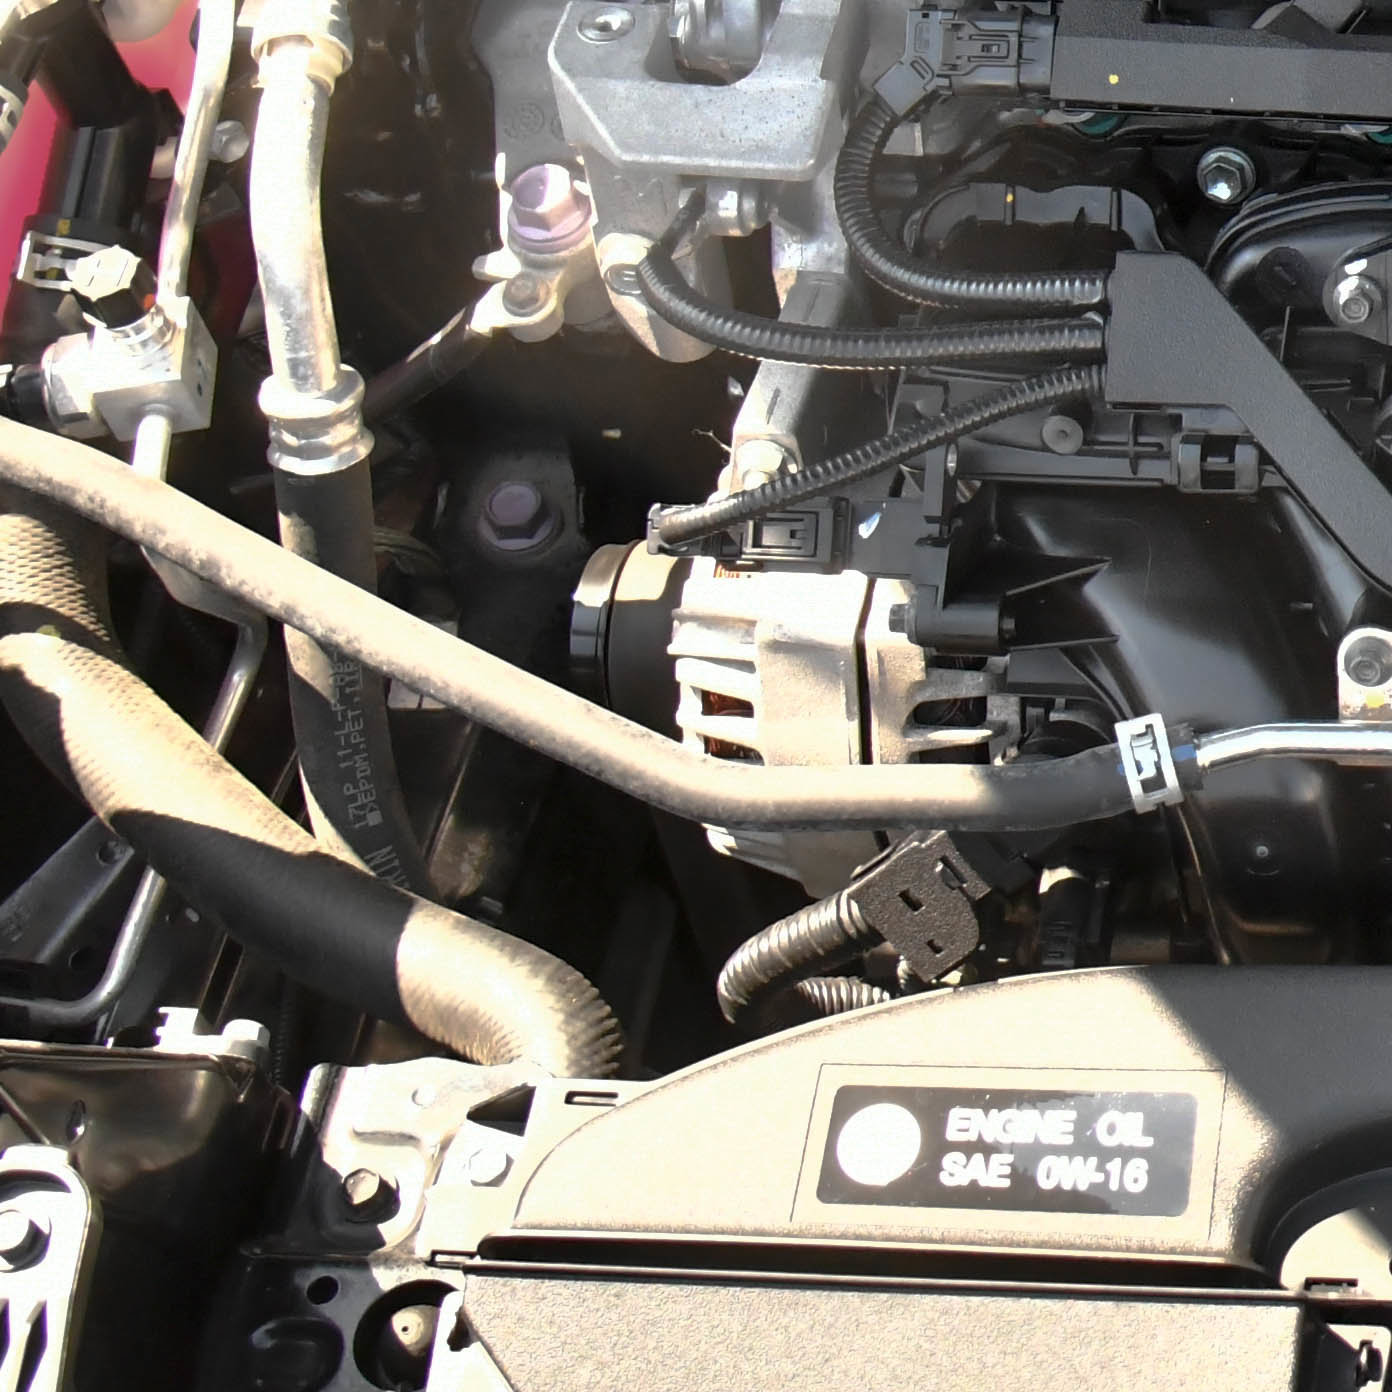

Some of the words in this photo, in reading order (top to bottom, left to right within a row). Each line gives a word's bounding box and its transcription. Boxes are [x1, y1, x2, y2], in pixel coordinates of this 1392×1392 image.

[945, 1107, 1078, 1145] ENGINE
[1095, 1110, 1154, 1147] OIL
[938, 1151, 1015, 1189] SAE
[1035, 1155, 1150, 1194] 0W-16
